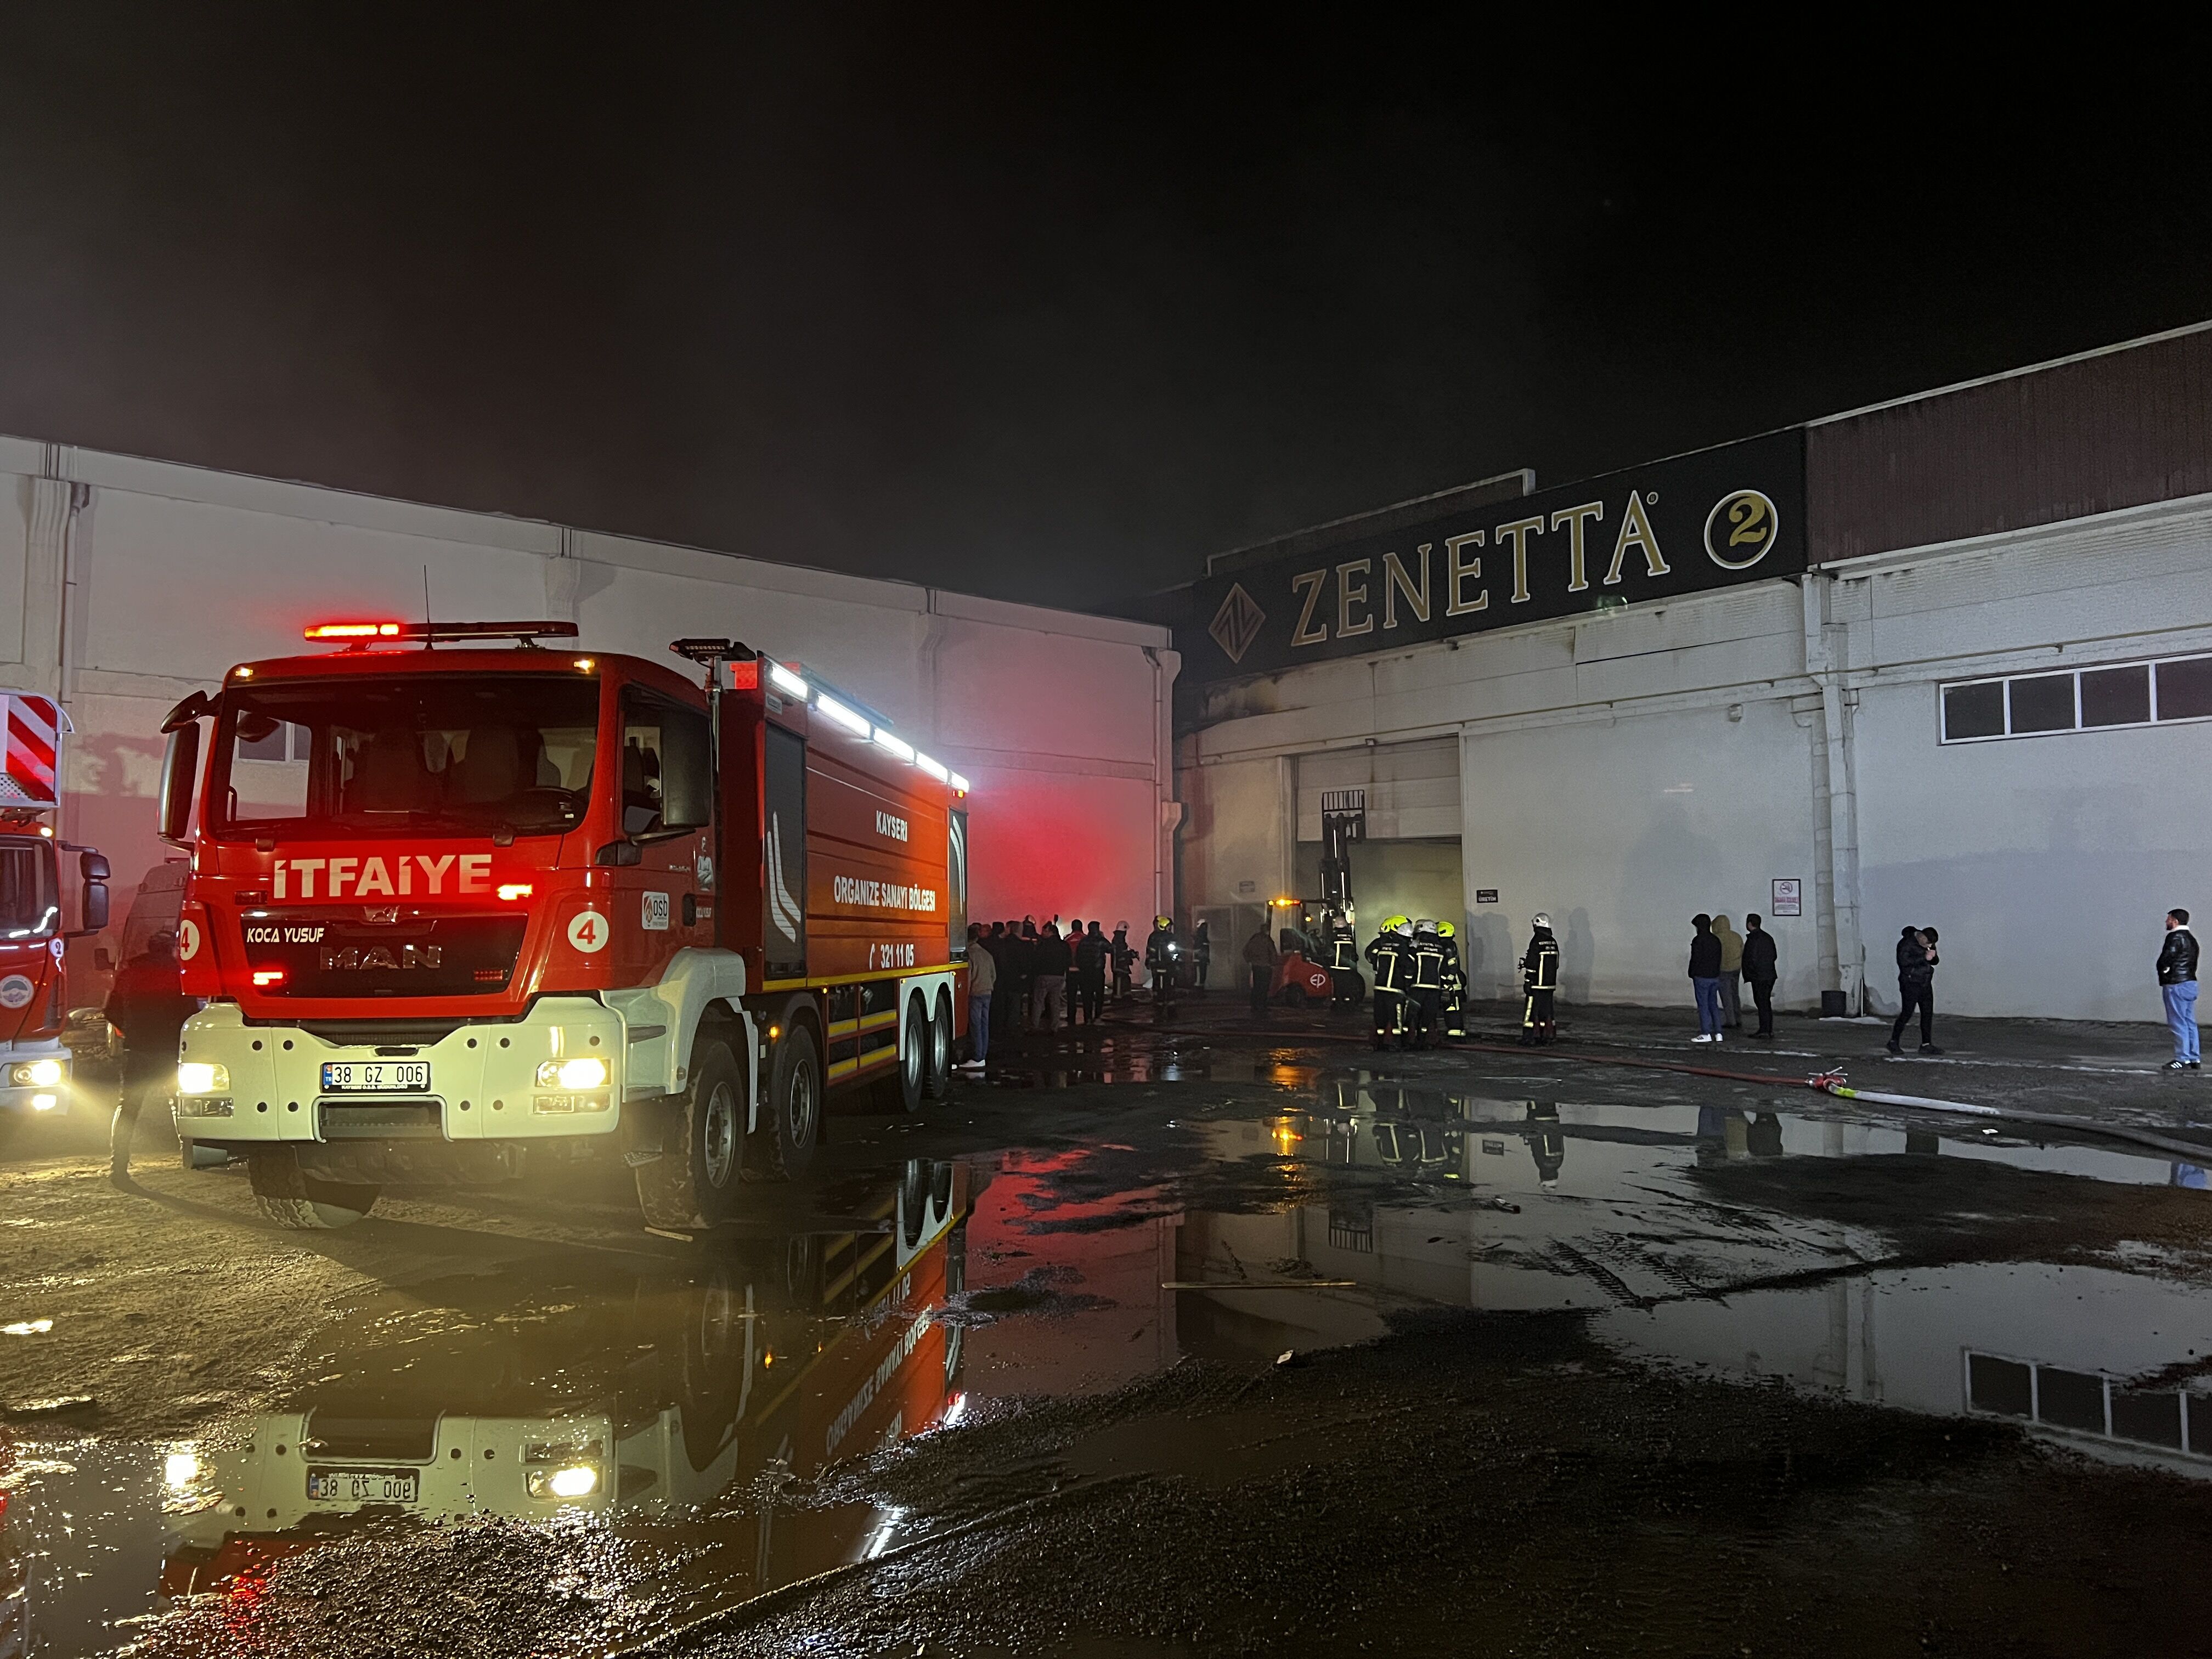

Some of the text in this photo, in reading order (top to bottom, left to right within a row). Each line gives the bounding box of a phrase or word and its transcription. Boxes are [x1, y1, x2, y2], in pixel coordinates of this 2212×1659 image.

[1729, 495, 1767, 546] 2
[1290, 490, 1671, 647] ZENETTA
[653, 895, 668, 916] osb
[181, 927, 190, 952] 4
[247, 927, 324, 943] KOCA YUSUF
[577, 919, 596, 944] 4
[55, 941, 61, 955] 2
[320, 945, 442, 970] MAN
[881, 944, 914, 968] 321 11 05
[335, 1066, 423, 1083] 38 GZ 006
